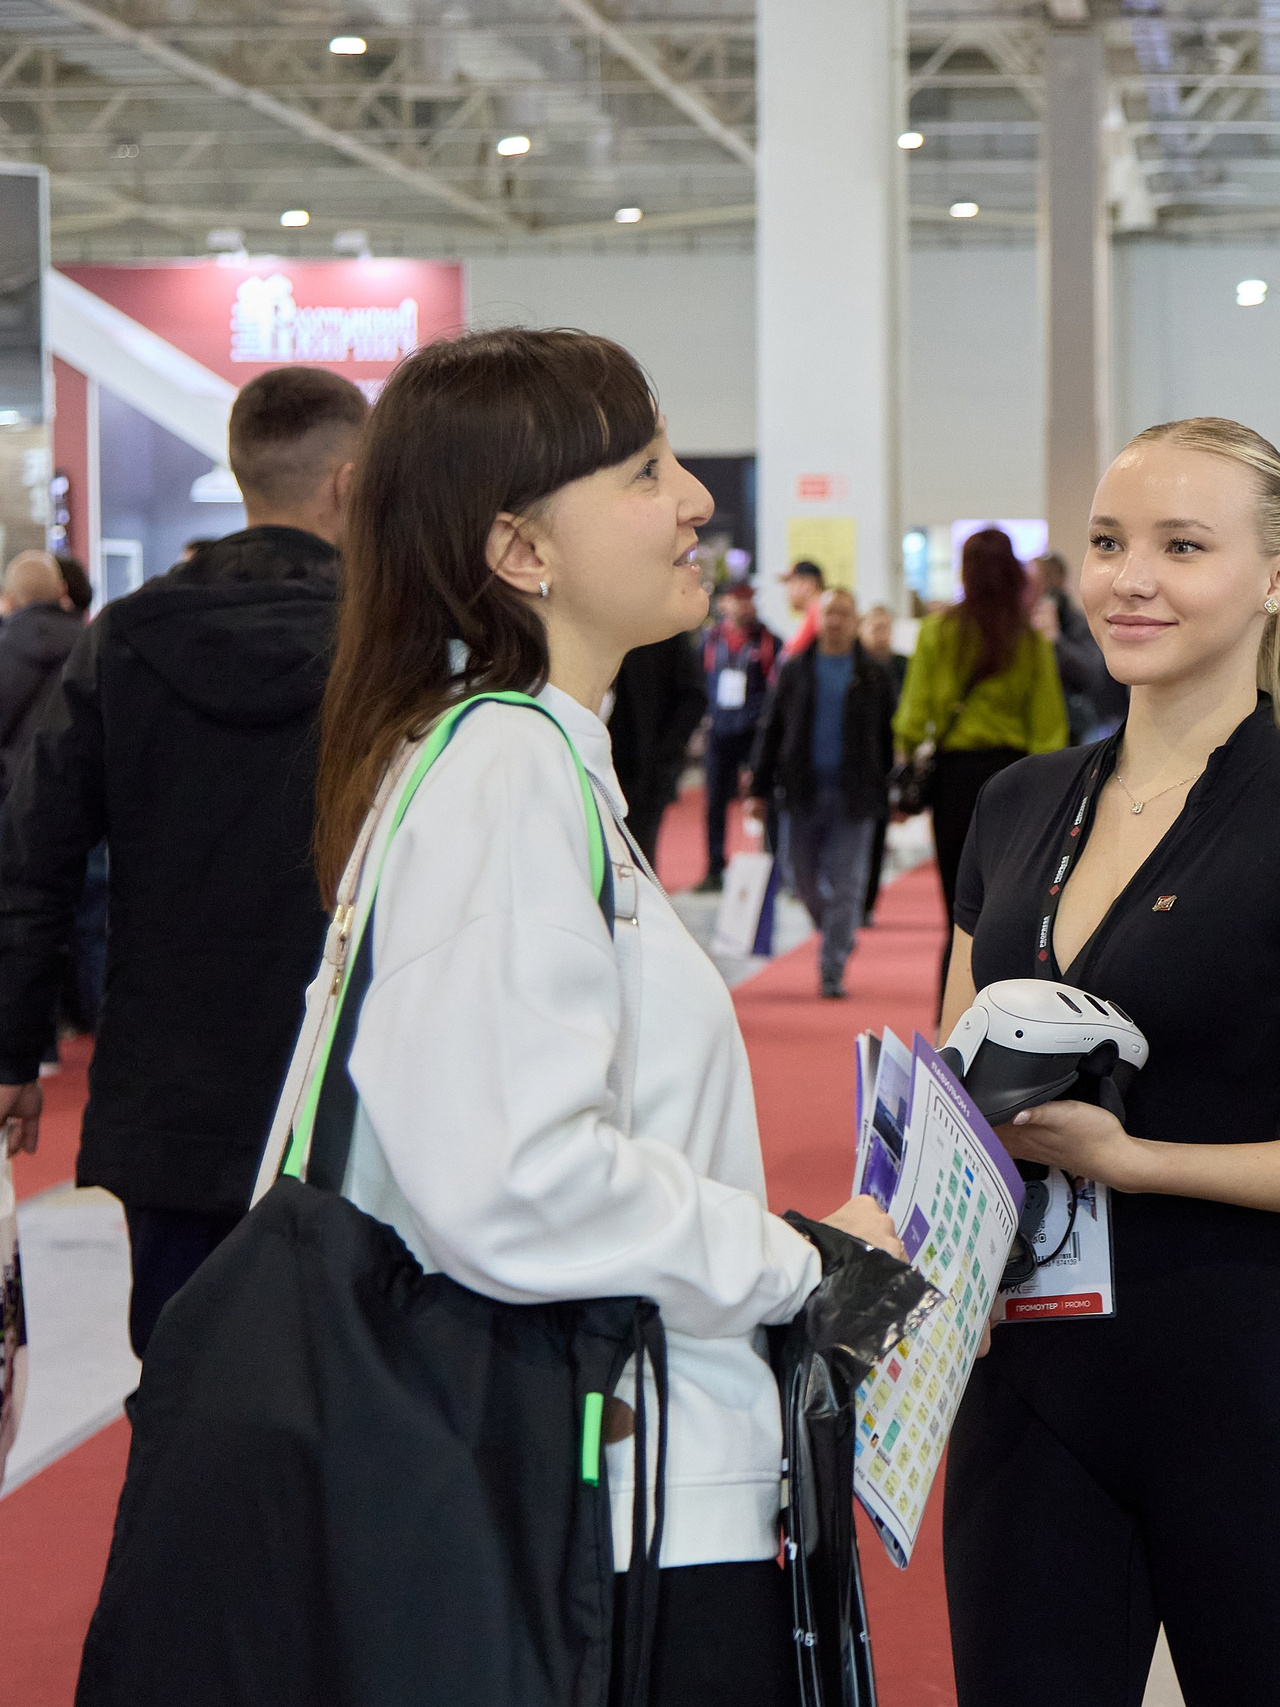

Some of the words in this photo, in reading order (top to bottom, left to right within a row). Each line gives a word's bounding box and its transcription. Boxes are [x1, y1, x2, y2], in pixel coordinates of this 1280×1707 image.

[1053, 855, 1070, 884] PROPRESS
[1039, 915, 1050, 948] PROPRESS
[1015, 1302, 1059, 1312] ПРОМОУТЕР
[1064, 1299, 1091, 1308] PROMO
